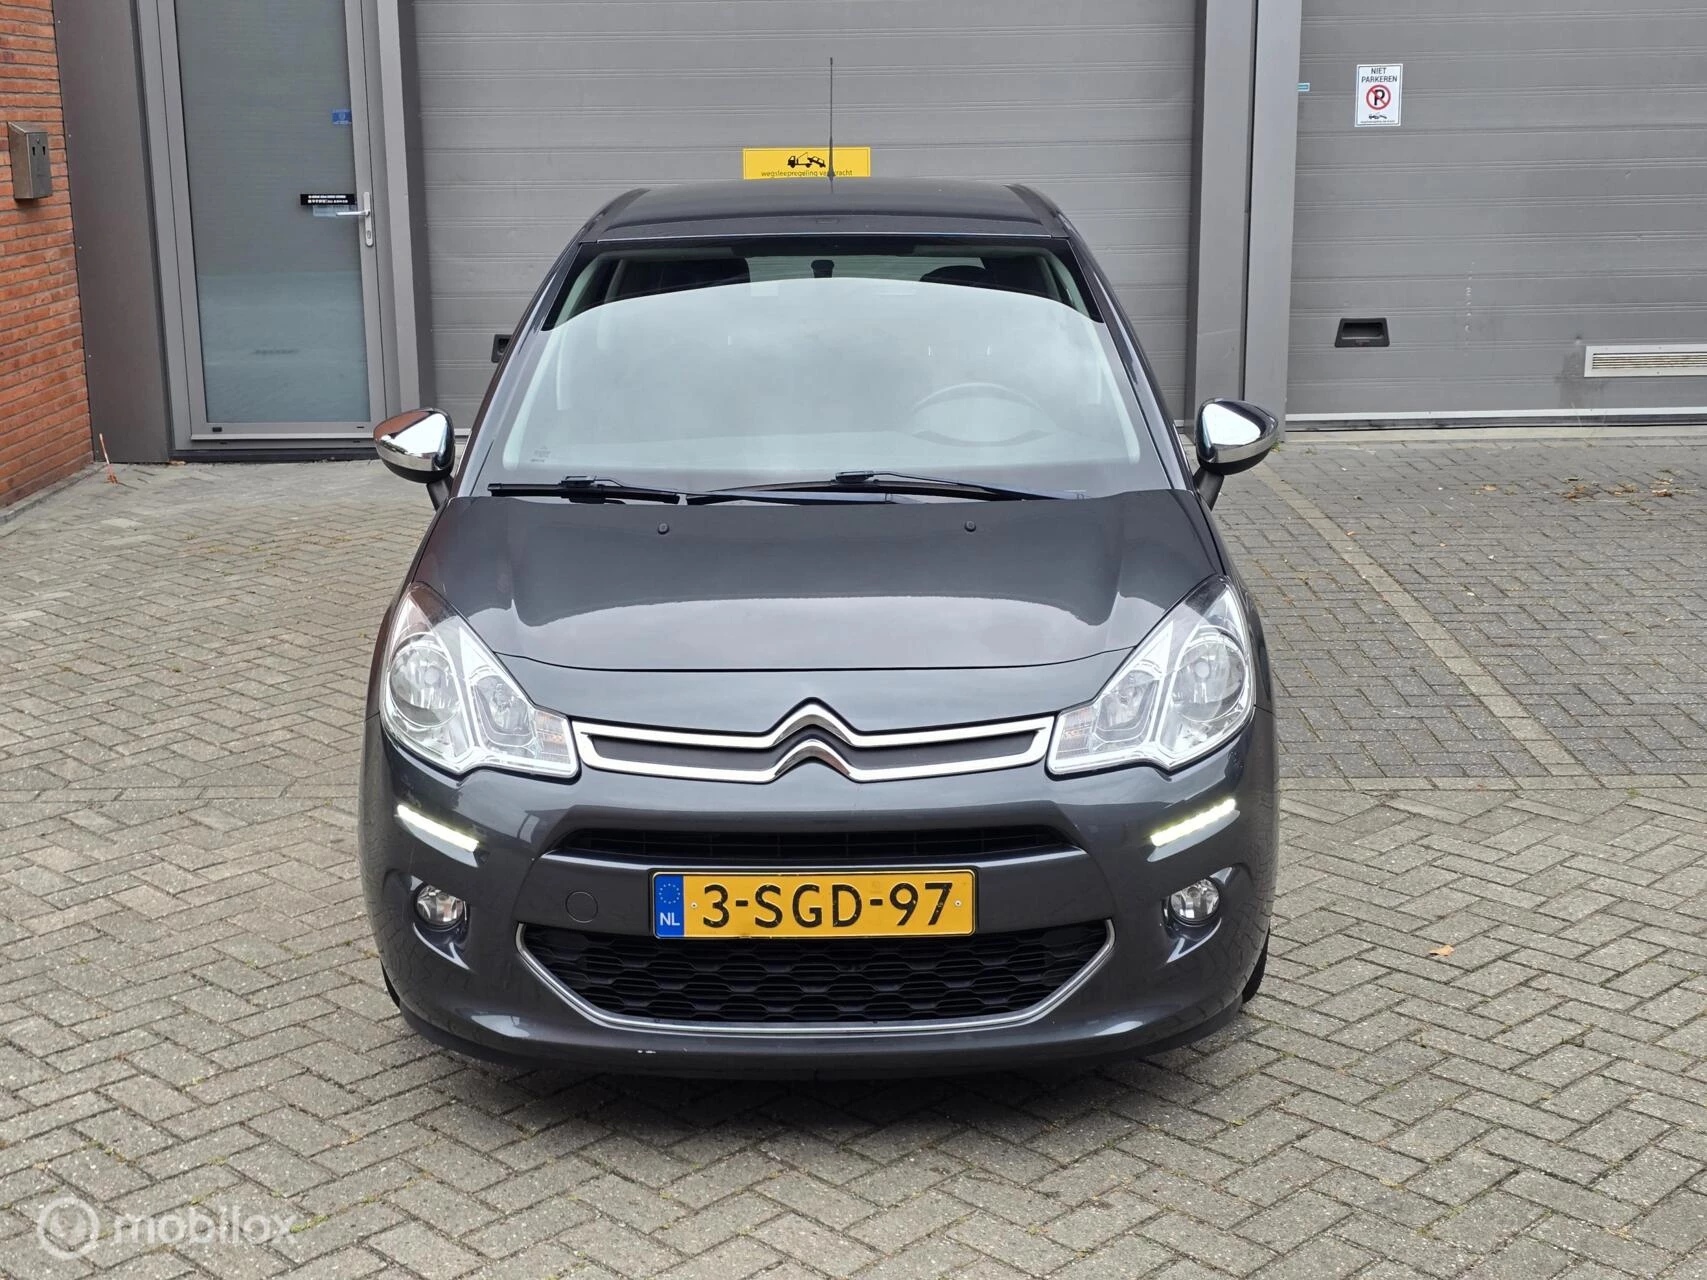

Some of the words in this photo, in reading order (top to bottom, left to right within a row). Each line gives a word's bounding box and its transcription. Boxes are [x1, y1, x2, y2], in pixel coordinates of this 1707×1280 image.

[1361, 75, 1398, 83] PARKEREN
[761, 170, 818, 178] wegsleepregeling
[702, 882, 953, 928] 3-SGD-97
[660, 912, 680, 926] NL
